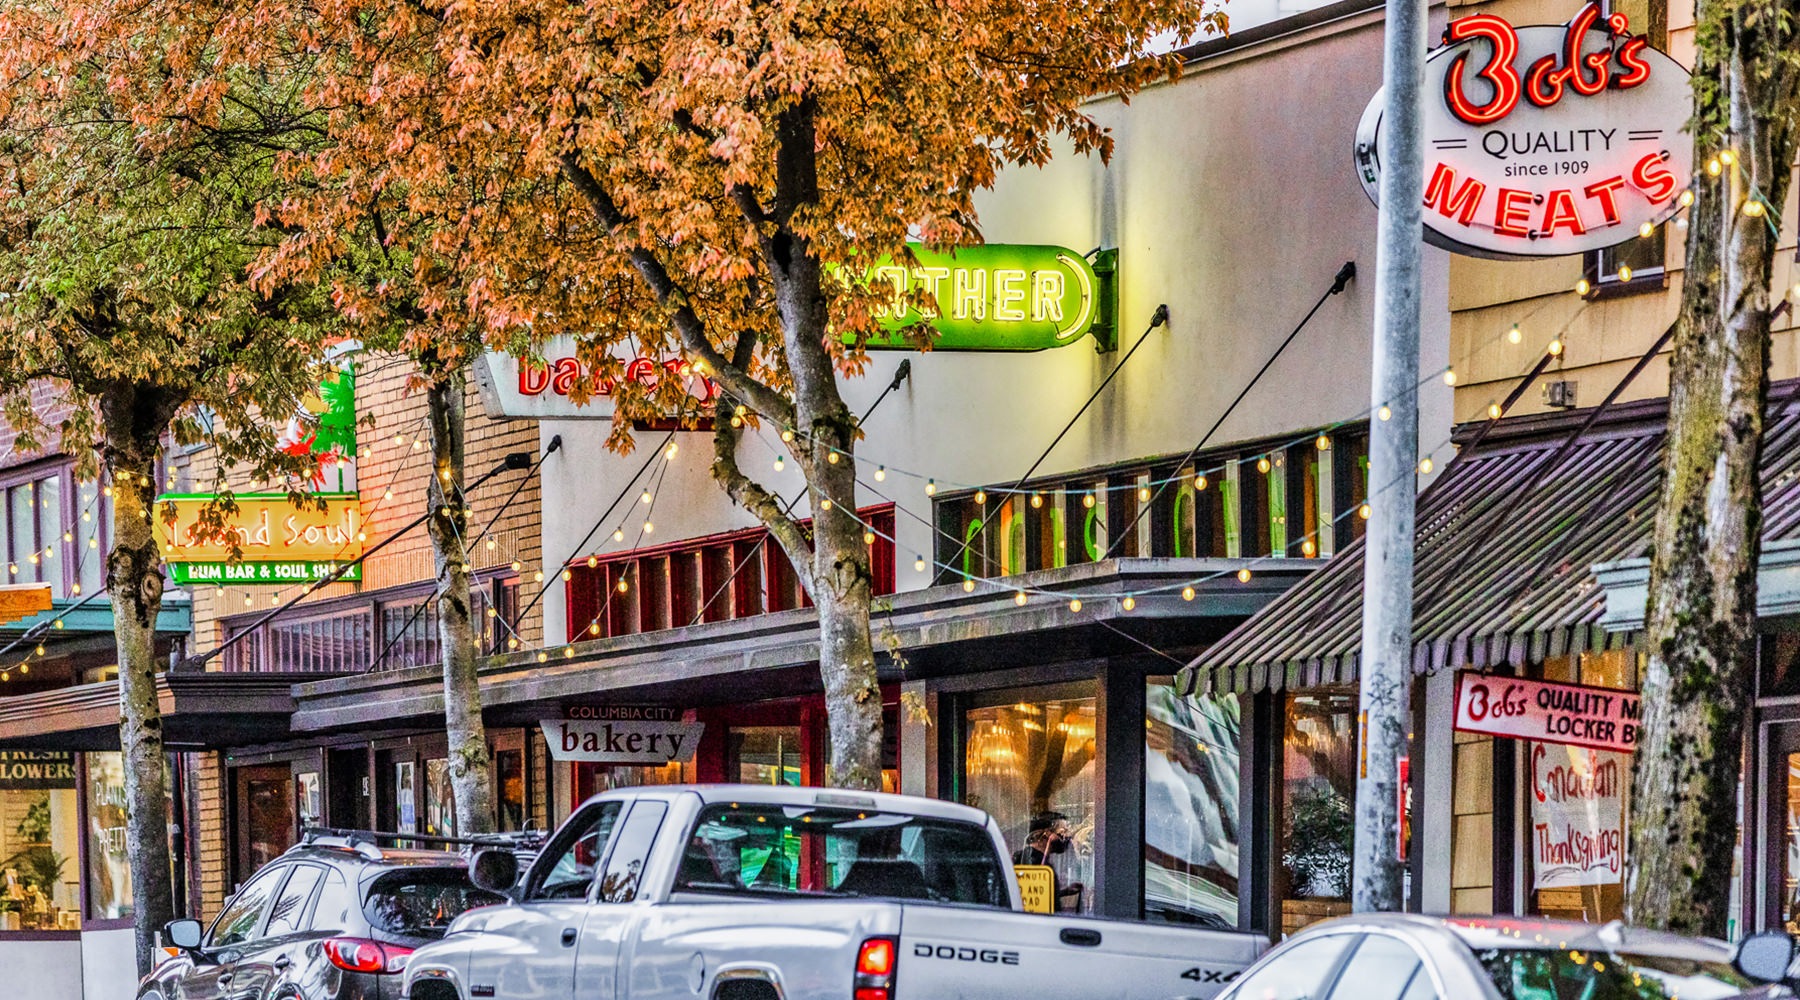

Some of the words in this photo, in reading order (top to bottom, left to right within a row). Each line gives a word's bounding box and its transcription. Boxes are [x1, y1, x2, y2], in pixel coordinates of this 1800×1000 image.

[1443, 2, 1651, 126] Bob's
[1482, 128, 1616, 159] QUALITY
[1505, 163, 1548, 176] since
[1555, 161, 1589, 175] 1909
[1424, 153, 1677, 237] MEATS
[834, 267, 1064, 322] OTHER
[284, 509, 353, 544] Soul
[226, 564, 255, 579] BAR
[260, 565, 270, 579] &
[275, 564, 309, 578] SOUL
[313, 563, 356, 578] SHK
[569, 706, 641, 719] COLUMBIA
[645, 707, 675, 720] CITY
[1468, 684, 1528, 721] Bob's
[1537, 688, 1613, 716] QUALITY
[1621, 698, 1640, 720] M
[559, 722, 685, 760] bakery
[1546, 714, 1616, 742] LOCKER
[1028, 885, 1044, 895] AND
[914, 943, 1020, 966] DODGE
